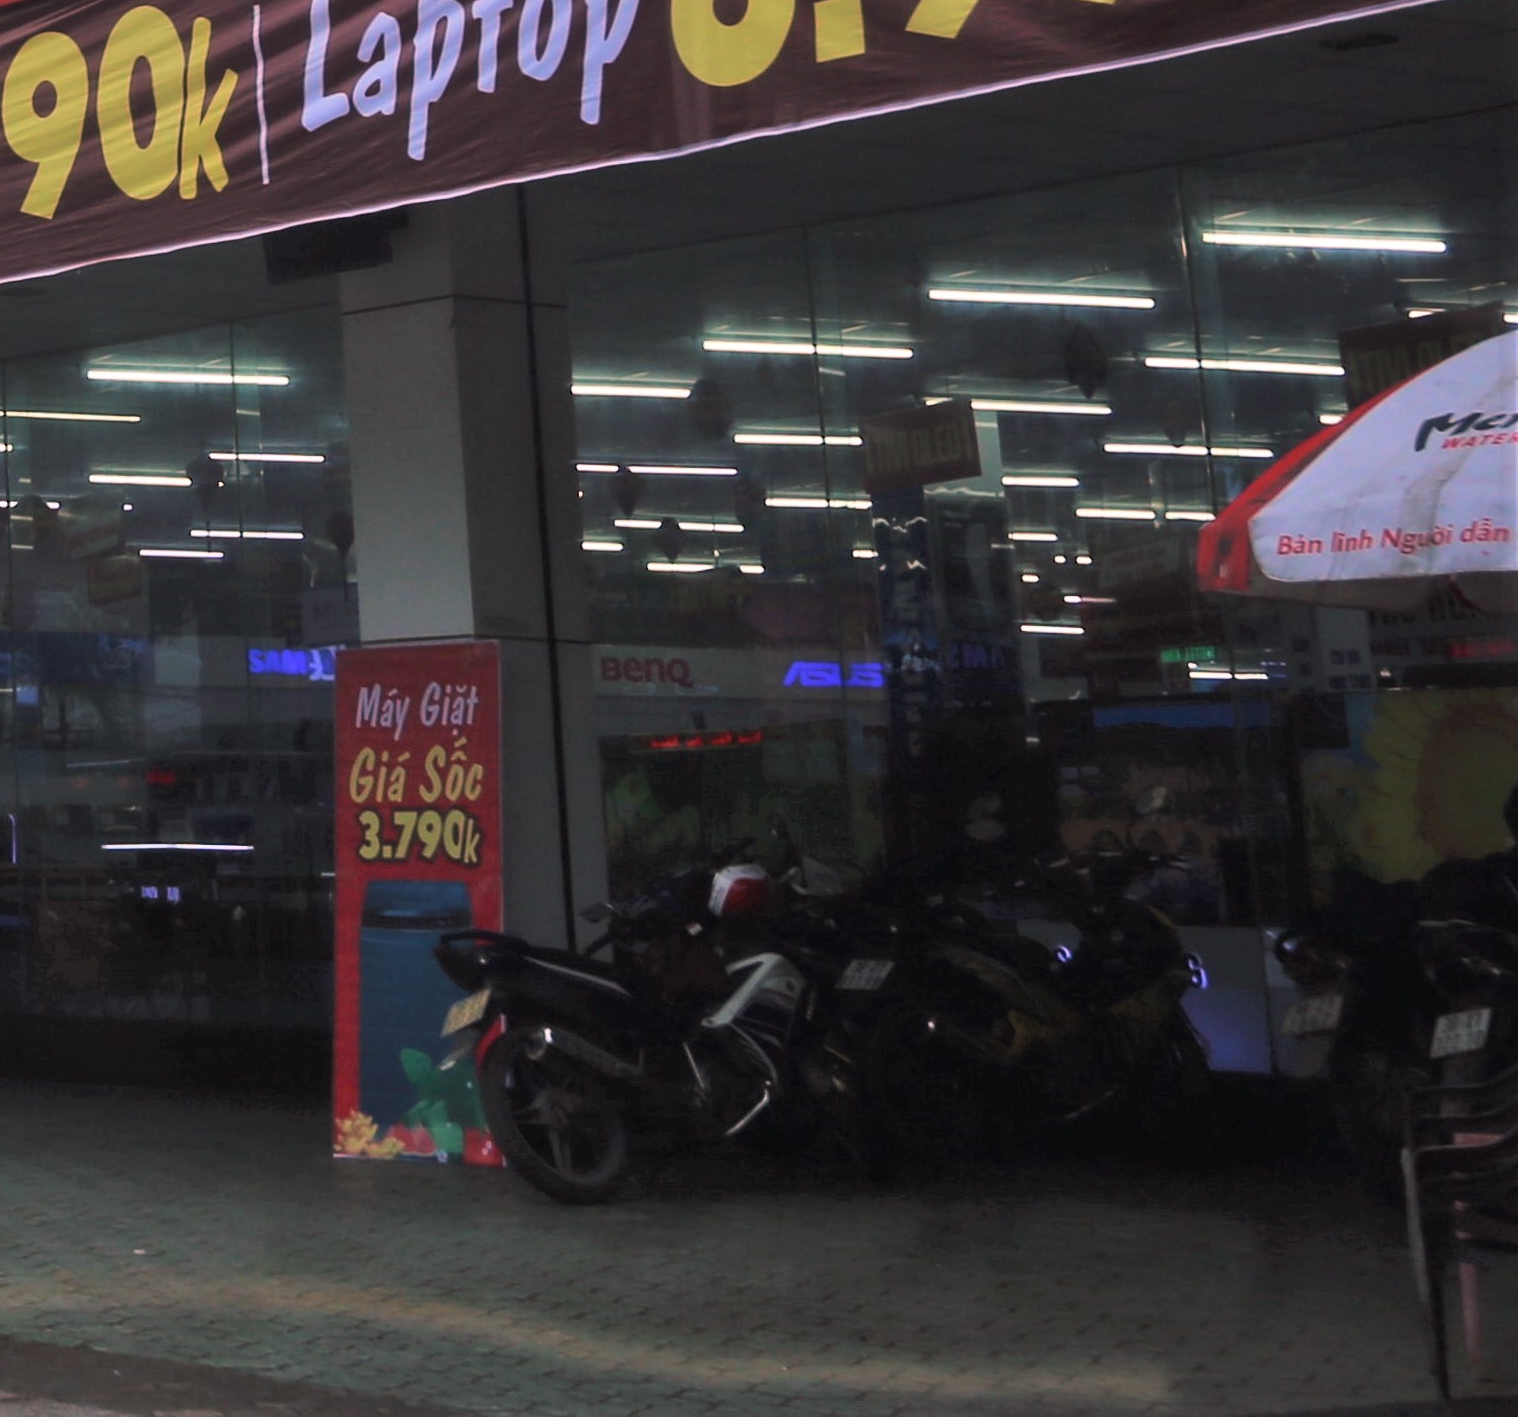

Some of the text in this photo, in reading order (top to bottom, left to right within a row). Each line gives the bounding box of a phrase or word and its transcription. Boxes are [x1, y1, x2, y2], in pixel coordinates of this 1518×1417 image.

[1276, 534, 1323, 556] Bản
[1330, 531, 1372, 553] lĩnh
[1380, 524, 1454, 555] Người
[355, 682, 479, 741] Máy Giặt
[349, 736, 484, 804] Giá Sốc
[358, 809, 481, 865] 3.790k
